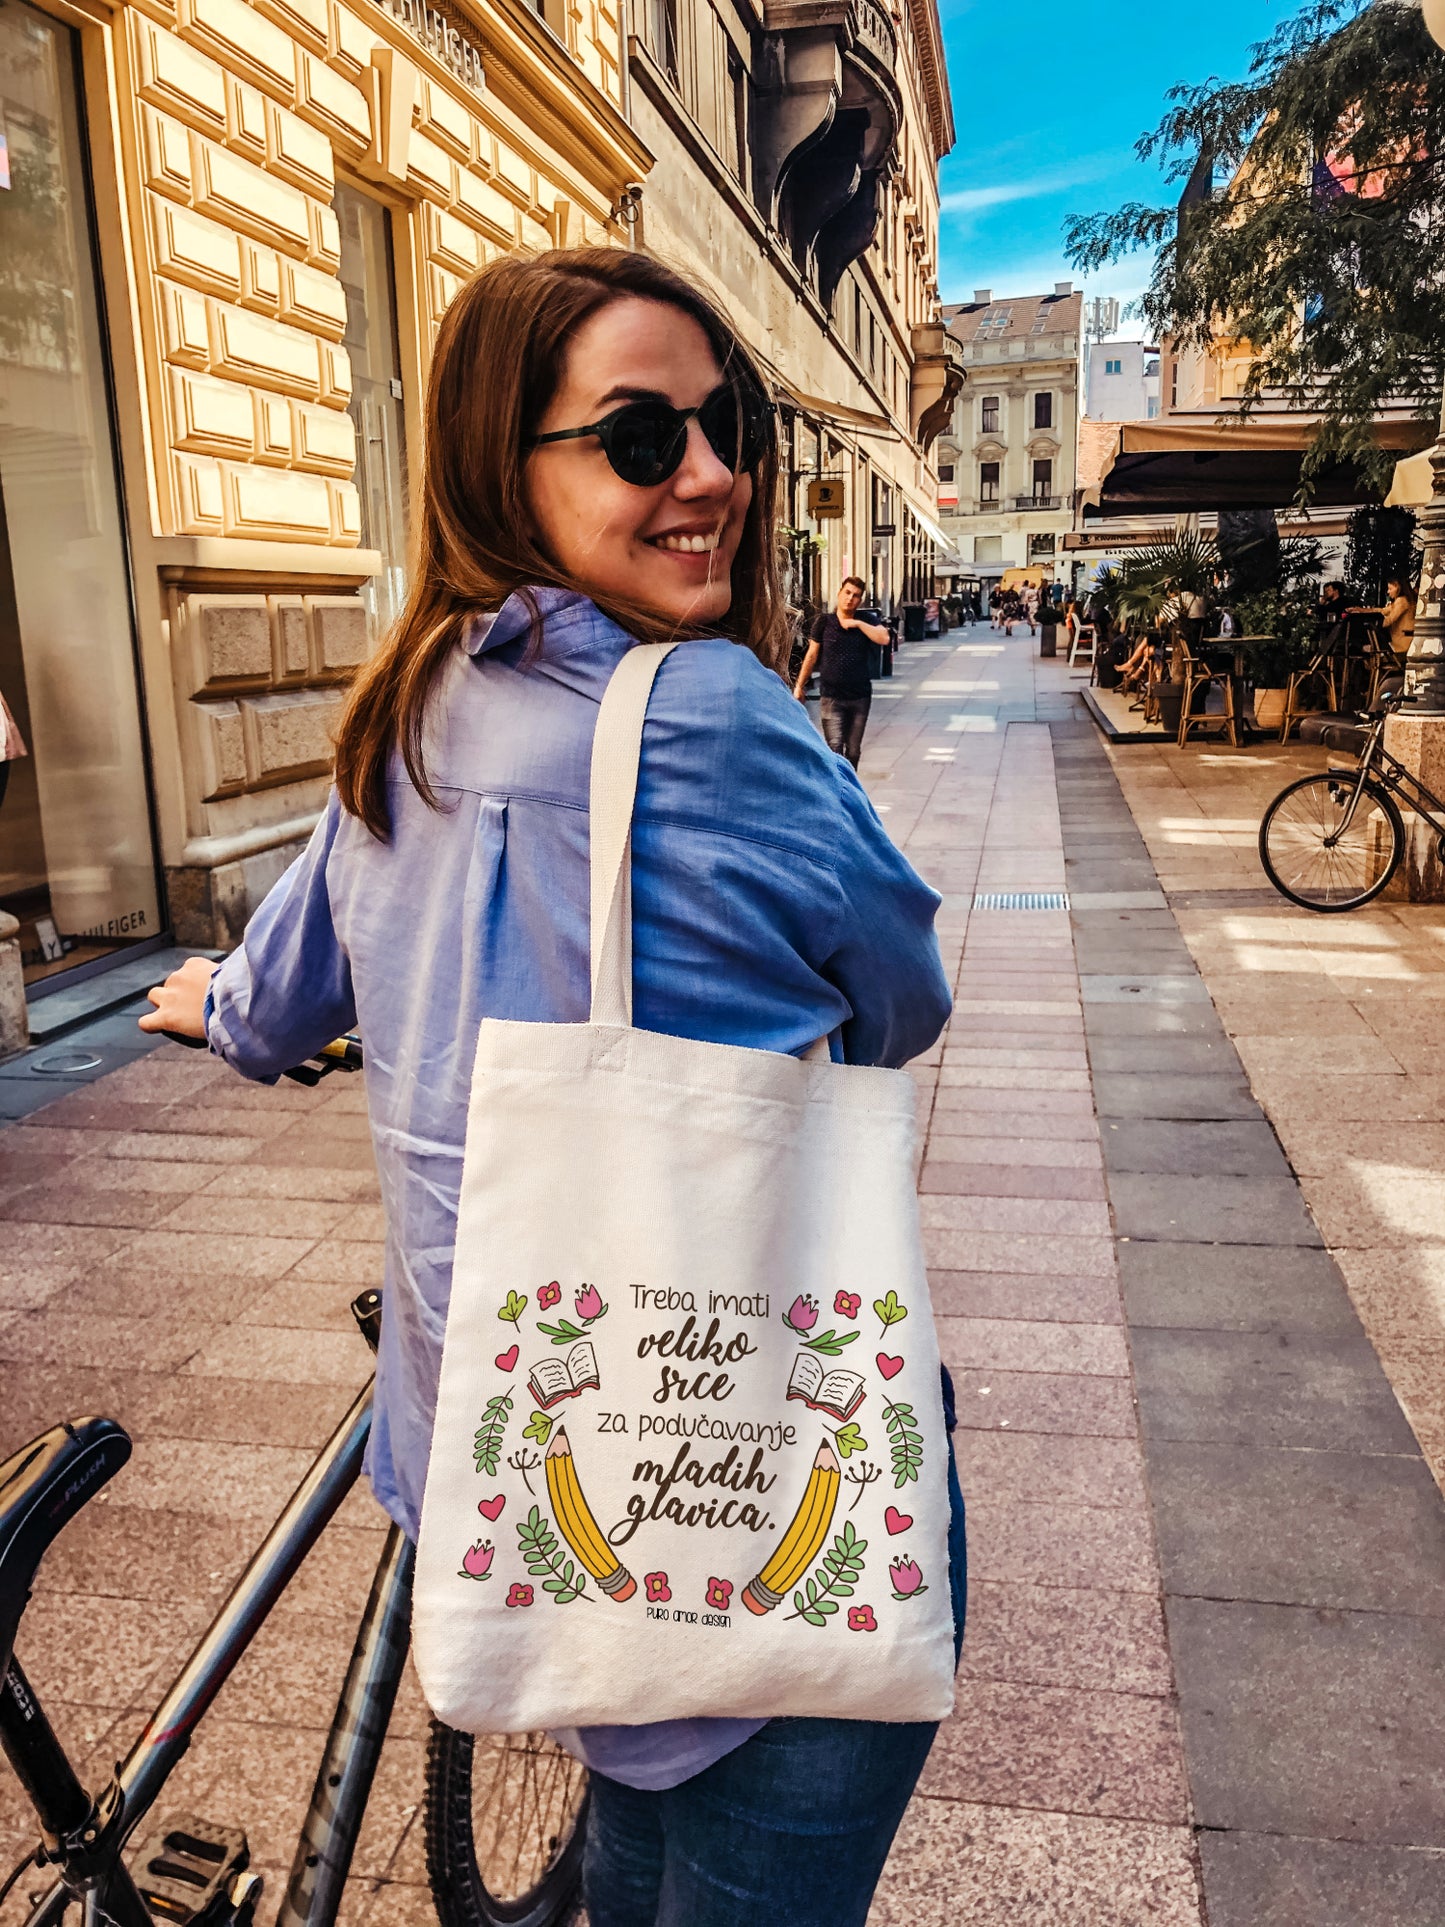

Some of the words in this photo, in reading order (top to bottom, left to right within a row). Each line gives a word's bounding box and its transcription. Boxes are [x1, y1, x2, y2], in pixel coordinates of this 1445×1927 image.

[630, 1284, 698, 1312] Treba
[708, 1290, 770, 1318] imati
[637, 1315, 758, 1366] veliko
[653, 1365, 736, 1404] srce
[597, 1413, 629, 1433] za
[638, 1413, 798, 1450] podučavanje
[632, 1441, 778, 1494] mladih
[607, 1477, 776, 1546] glavica.
[646, 1607, 670, 1621] PURO
